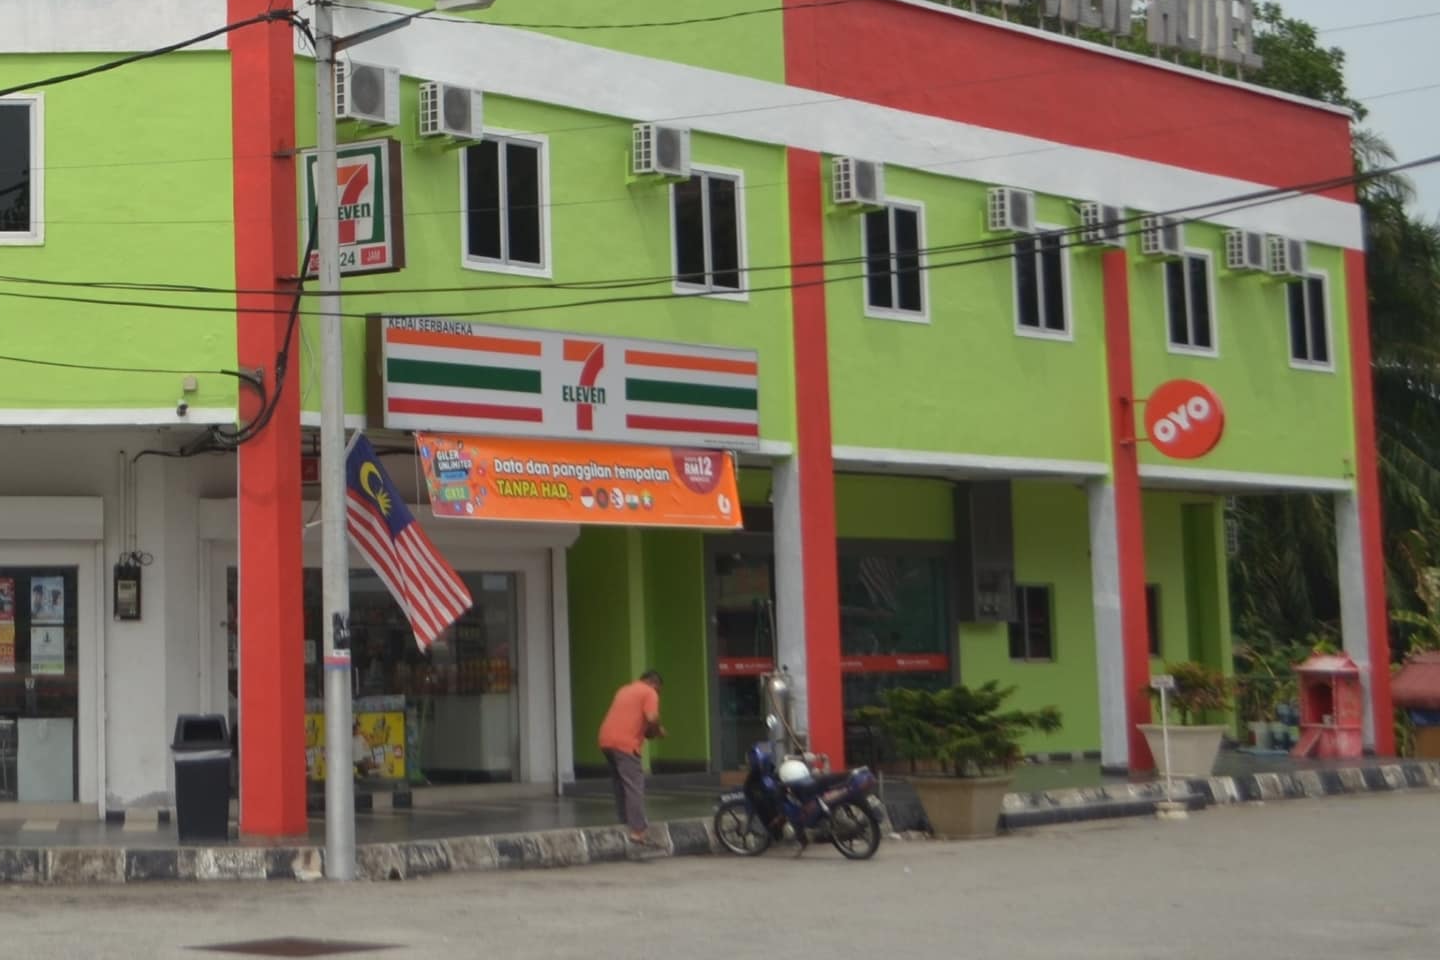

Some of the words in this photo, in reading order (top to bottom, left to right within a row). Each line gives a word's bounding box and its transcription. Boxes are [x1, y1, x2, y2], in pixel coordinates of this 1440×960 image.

[340, 251, 355, 267] 24
[388, 316, 417, 330] KEDAI
[419, 319, 474, 336] SERBANEKA
[563, 339, 605, 432] 7
[1153, 396, 1210, 443] OYO
[494, 458, 523, 474] Data
[526, 460, 550, 476] dan
[553, 463, 611, 481] panggilan
[614, 465, 670, 482] tempatan
[497, 480, 538, 497] TANPA
